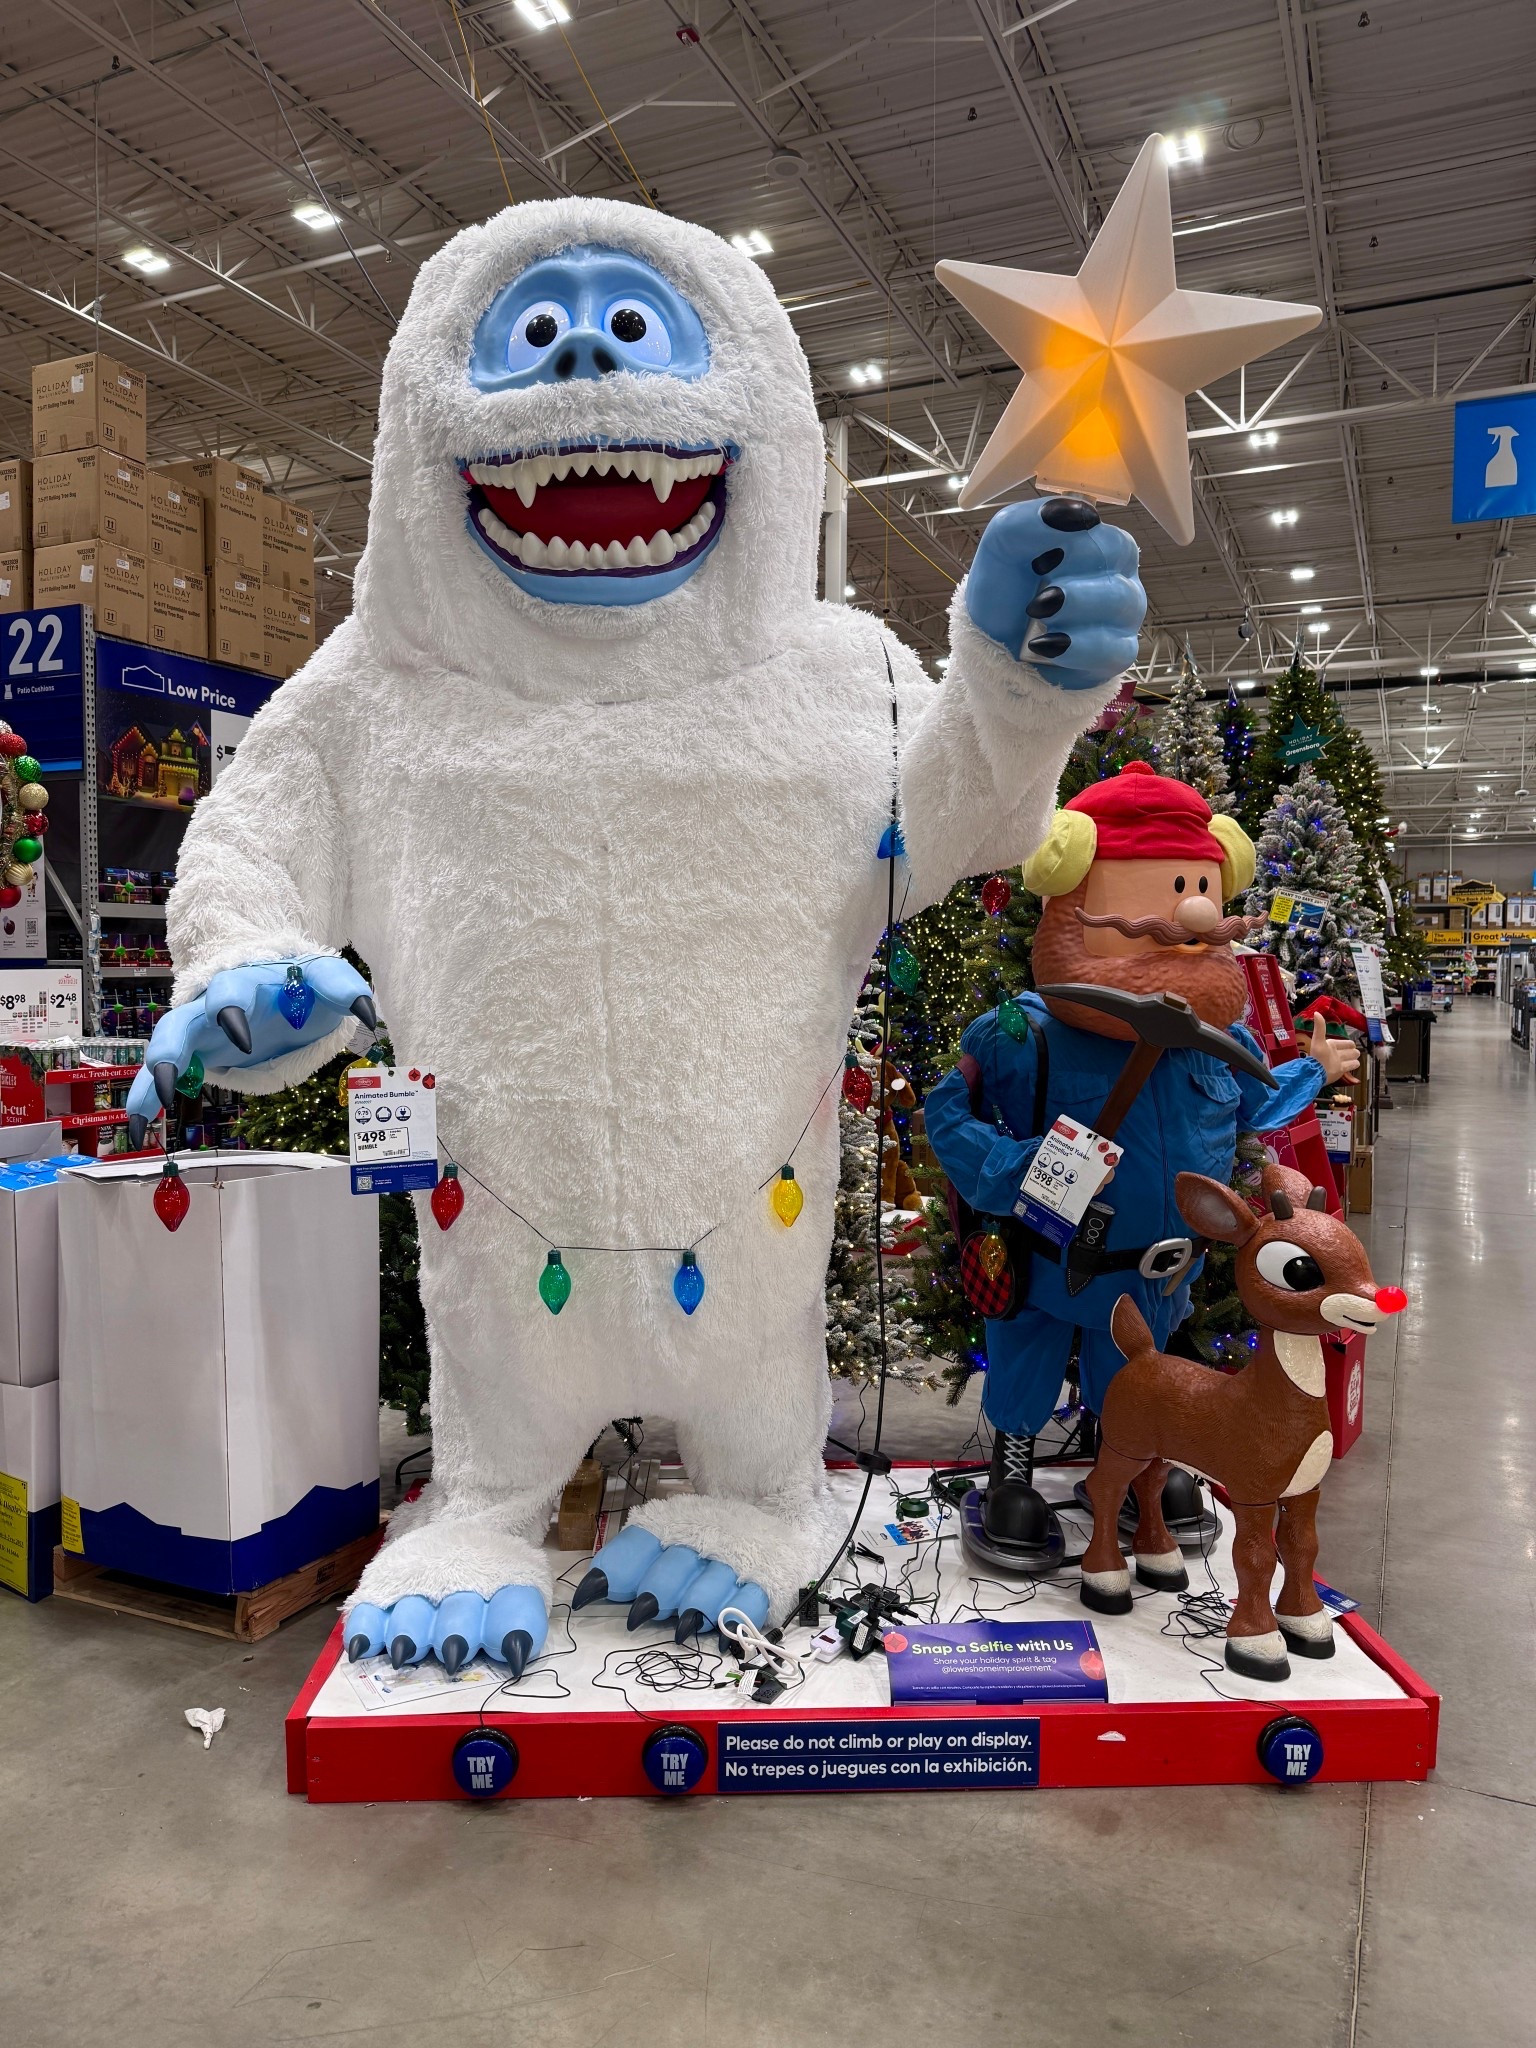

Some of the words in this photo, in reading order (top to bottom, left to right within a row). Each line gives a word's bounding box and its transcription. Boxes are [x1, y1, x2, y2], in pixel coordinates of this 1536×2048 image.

[37, 380, 70, 394] HOLIDAY
[103, 379, 138, 400] HOLIDAY
[38, 473, 72, 486] HOLIDAY
[104, 472, 139, 492] HOLIDAY
[220, 485, 255, 503] HOLIDAY
[151, 495, 188, 513] HOLIDAY
[264, 517, 295, 533] OLIDAY
[38, 565, 71, 576] HOLIDAY
[104, 566, 140, 582] HOLIDAY
[154, 582, 191, 599] HOLIDAY
[220, 586, 255, 602] HOLIDAY
[8, 614, 63, 675] 22
[31, 685, 54, 693] Cushions
[168, 678, 198, 699] Low
[201, 686, 236, 708] Price
[1289, 734, 1312, 744] HOLIDAY
[1286, 743, 1320, 756] Greensboro
[355, 1091, 388, 1100] Animated
[72, 1116, 107, 1125] Christmas
[357, 1131, 386, 1143] $498
[1050, 1135, 1074, 1151] Animated
[1075, 1149, 1090, 1161] Yukon
[1033, 1167, 1053, 1186] $398
[912, 1644, 952, 1656] Snap
[969, 1641, 1013, 1653] Selfie
[1016, 1641, 1051, 1651] with
[1053, 1640, 1074, 1651] Us
[980, 1656, 1009, 1665] holiday
[1012, 1656, 1032, 1664] spirit
[1042, 1656, 1057, 1664] tag
[942, 1664, 1052, 1674] @loweshomeimprovement
[726, 1735, 779, 1751] Please
[783, 1735, 804, 1749] do
[808, 1735, 835, 1749] not
[839, 1734, 883, 1749] climb
[886, 1737, 904, 1748] or
[908, 1733, 943, 1750] play
[946, 1736, 967, 1747] on
[971, 1732, 1032, 1749] display.
[1284, 1744, 1311, 1760] TRY
[467, 1756, 495, 1773] TRY
[661, 1753, 688, 1769] TRY
[726, 1762, 748, 1777] No
[751, 1763, 804, 1779] trepes
[808, 1765, 819, 1776] o
[821, 1760, 887, 1778] juegues
[890, 1763, 920, 1774] con
[924, 1759, 939, 1773] la
[943, 1757, 1032, 1773] exhibición.
[1286, 1762, 1307, 1776] ME
[472, 1774, 494, 1789] ME
[664, 1771, 685, 1786] ME
